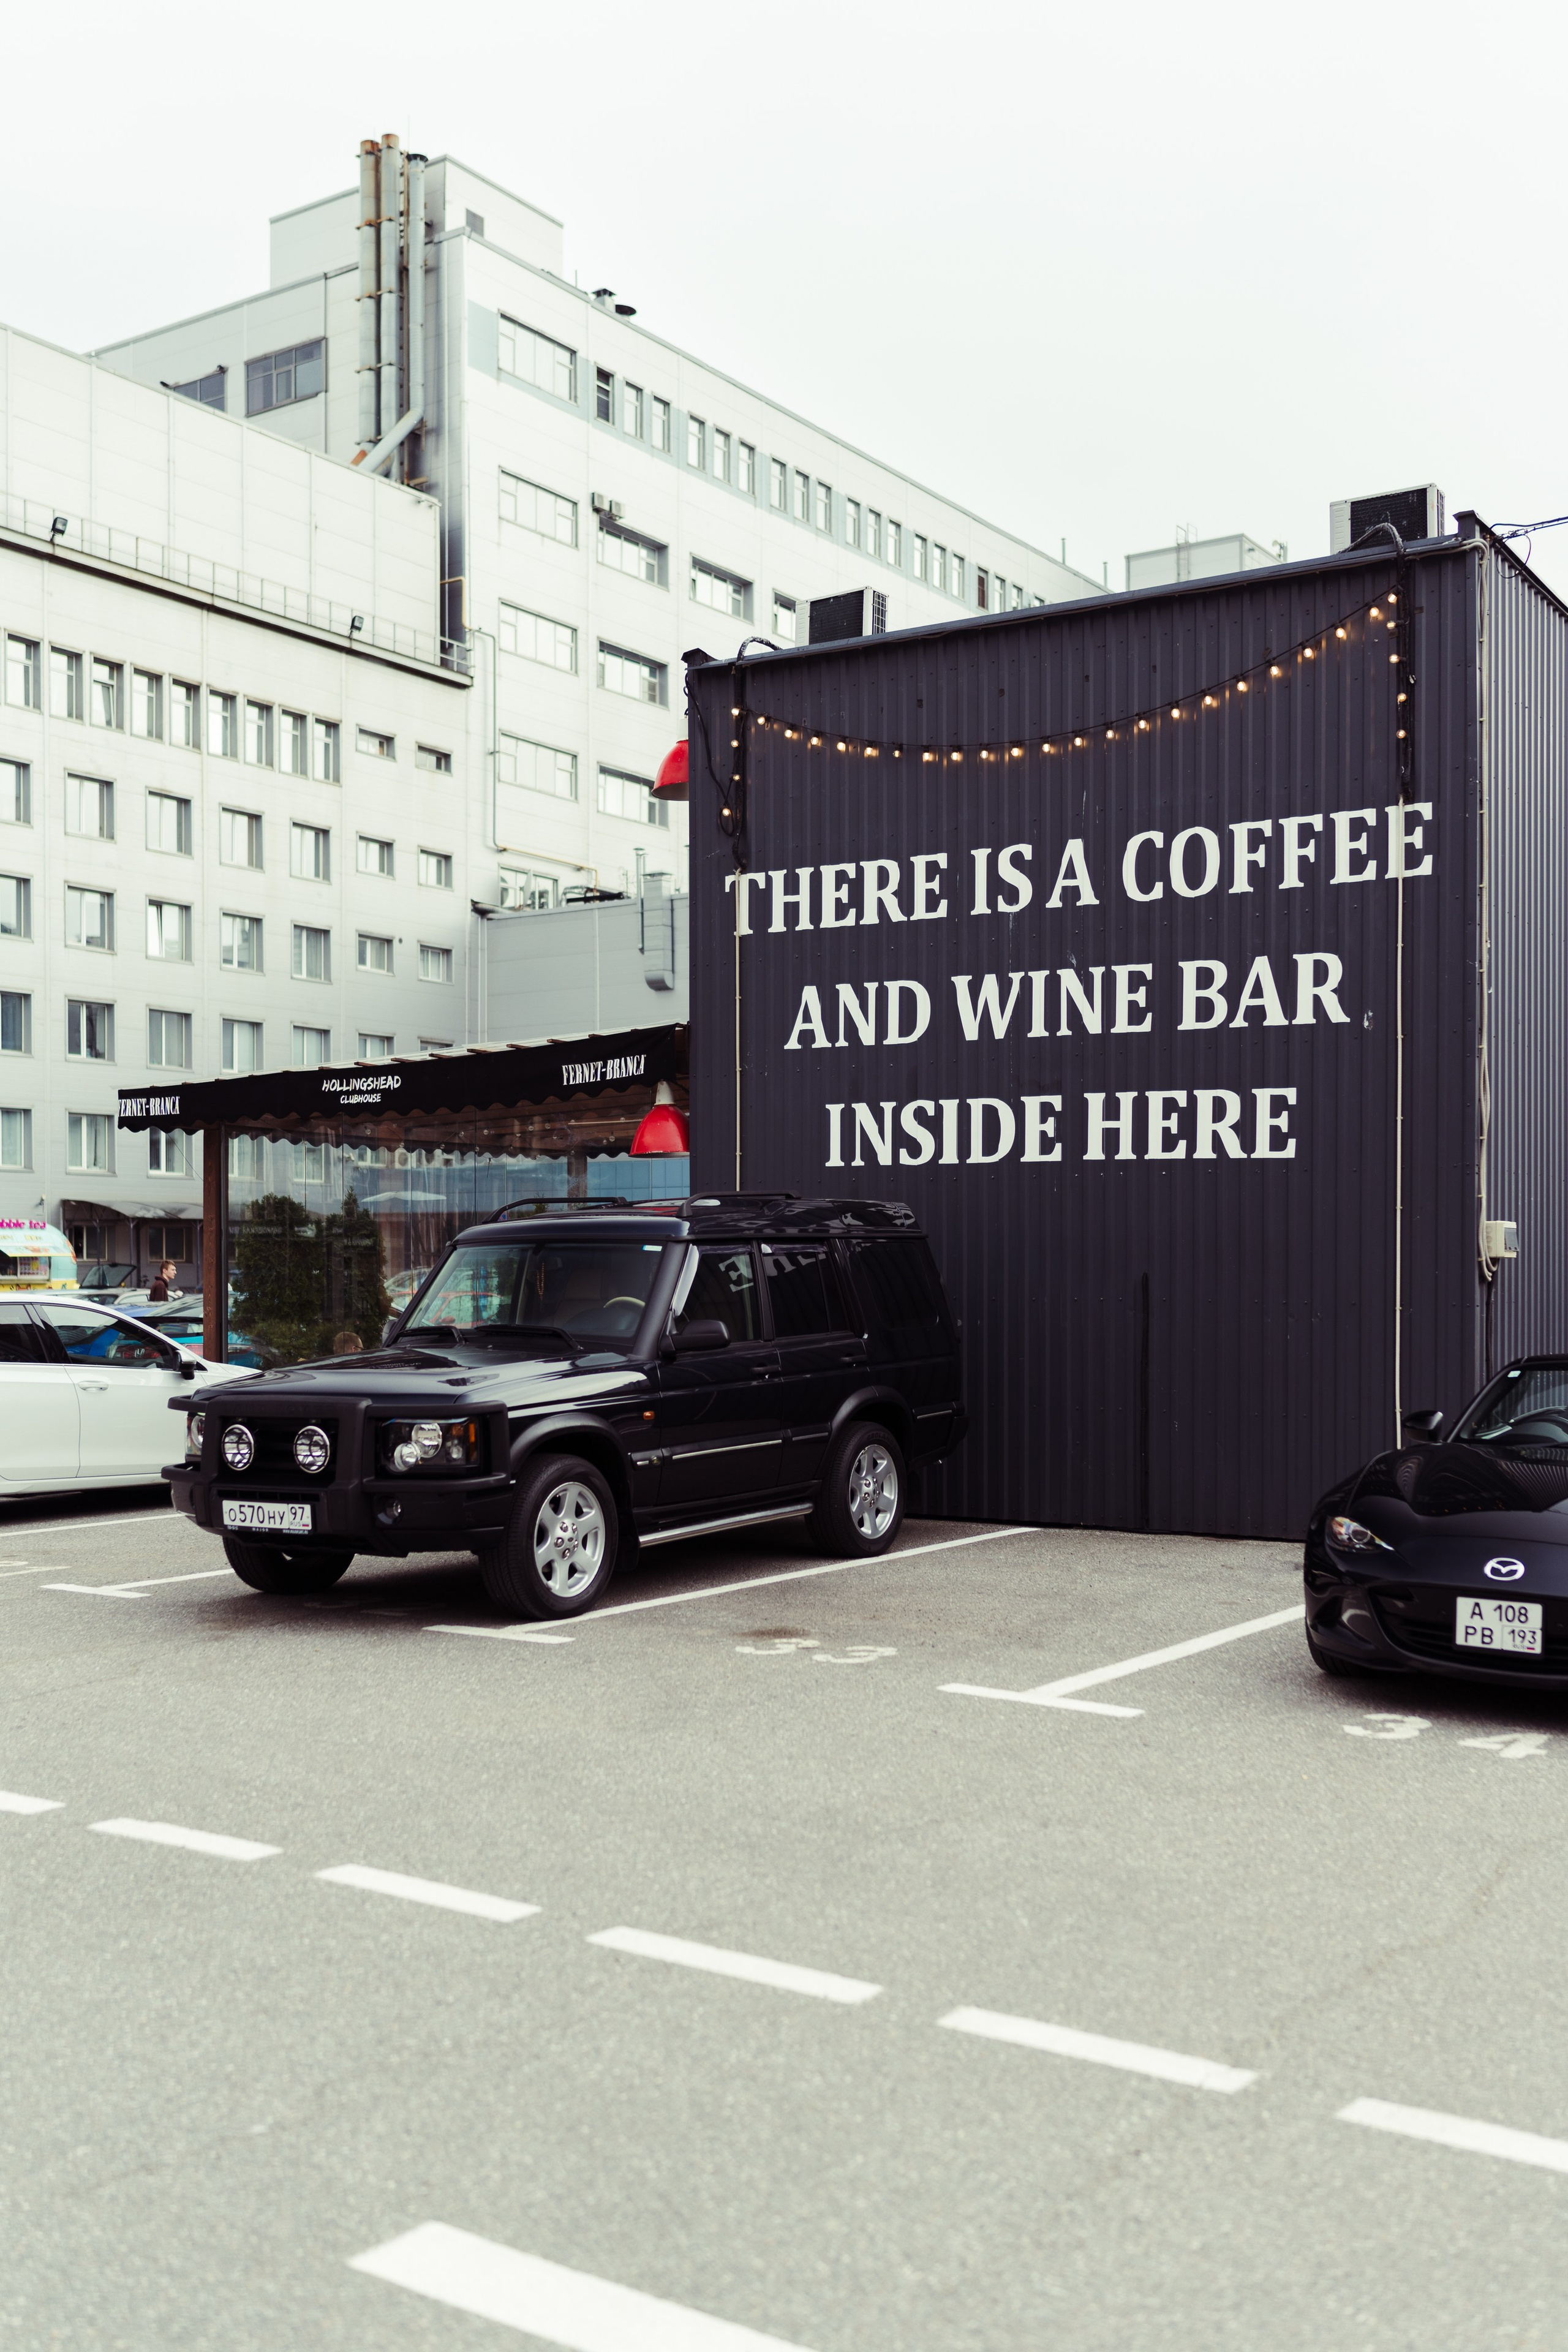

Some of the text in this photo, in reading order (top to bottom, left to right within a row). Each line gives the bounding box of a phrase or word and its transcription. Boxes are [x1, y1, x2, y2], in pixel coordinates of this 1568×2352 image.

[725, 802, 1433, 937] THERE IS A COFFEE
[784, 952, 1351, 1050] AND WINE BAR
[562, 1054, 645, 1085] FERNET-BRANCA
[322, 1076, 401, 1091] HOLLINGSHEAD
[340, 1093, 381, 1104] CLUBHOUSE
[825, 1088, 1297, 1167] INSIDE HERE
[0, 1219, 46, 1229] bble tea
[290, 1506, 305, 1521] 97
[1493, 1604, 1529, 1623] 108
[1508, 1629, 1536, 1644] 193
